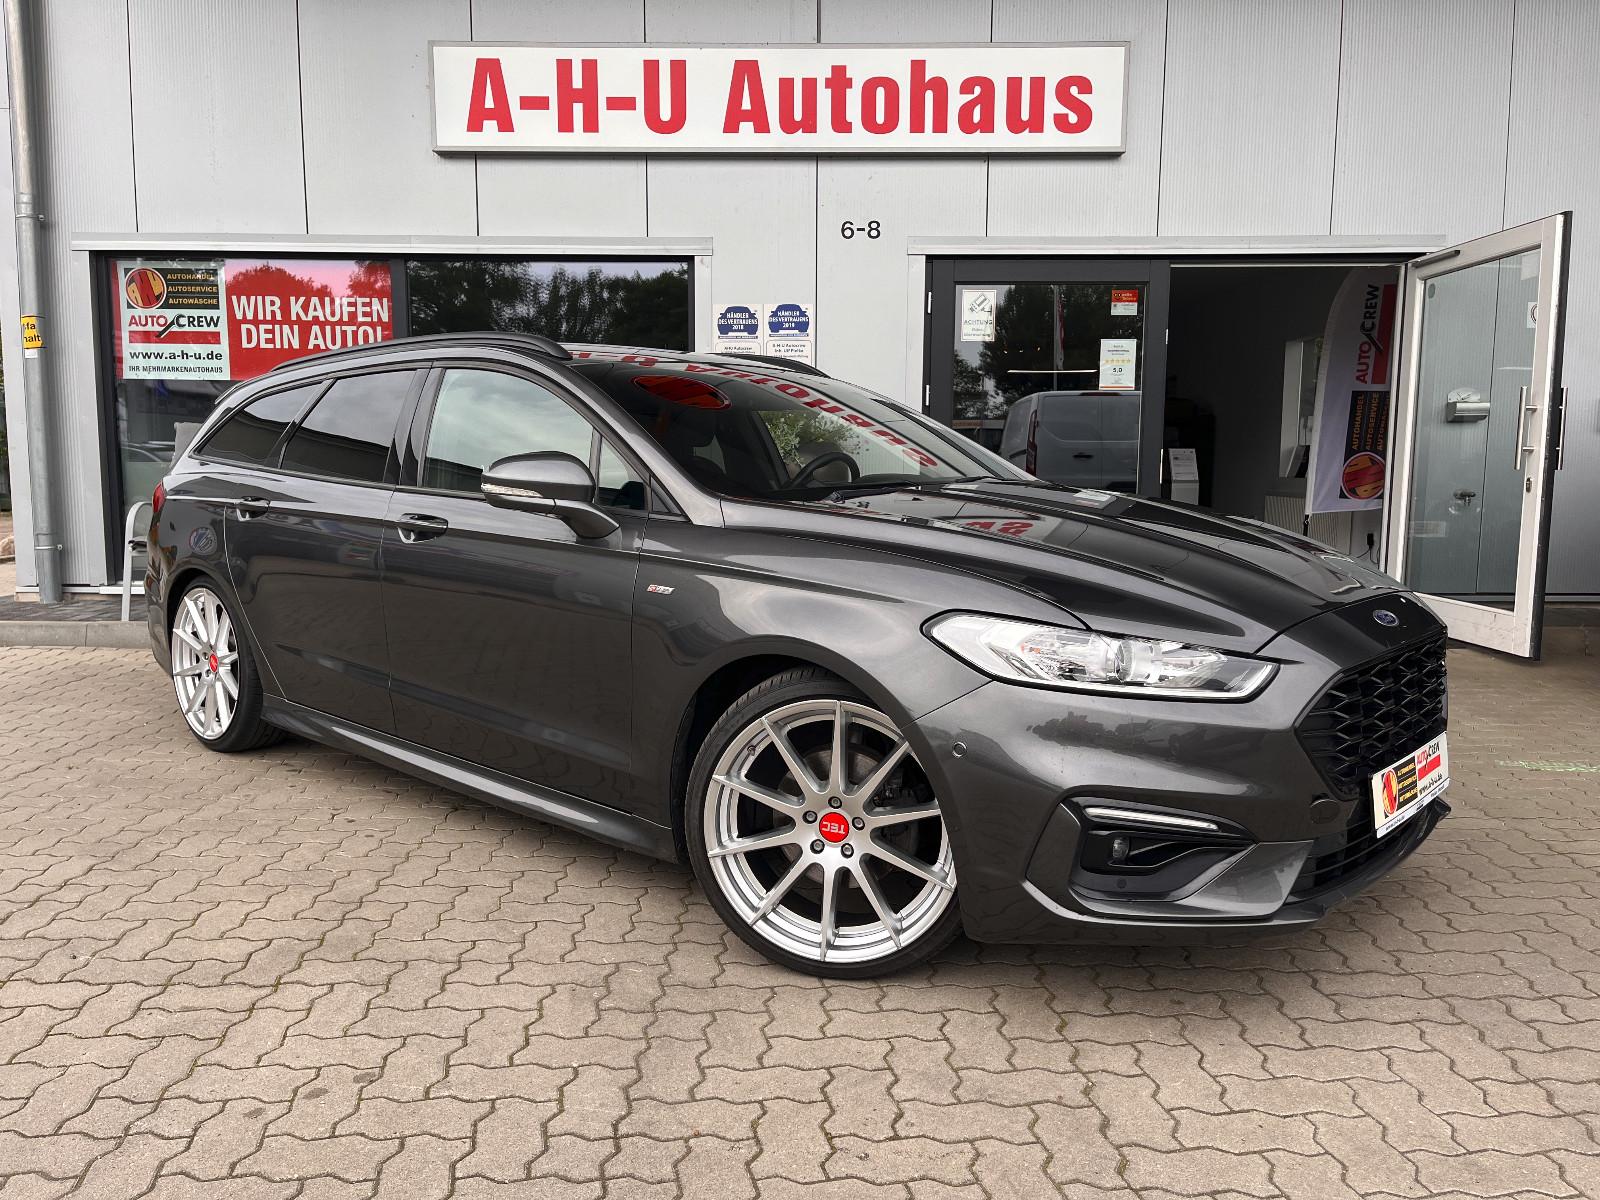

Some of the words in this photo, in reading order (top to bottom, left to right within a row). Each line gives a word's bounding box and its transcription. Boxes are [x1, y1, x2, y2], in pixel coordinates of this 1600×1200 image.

[465, 57, 688, 135] A-H-U
[722, 57, 1094, 135] Autohaus
[840, 219, 882, 241] 6-8
[168, 285, 218, 293] AUTOSERVICE
[232, 295, 282, 321] WIR
[290, 296, 389, 323] KAUFEN
[240, 323, 300, 349] DEIN
[129, 350, 223, 361] www.a-h-u.de
[821, 821, 846, 835] TEC
